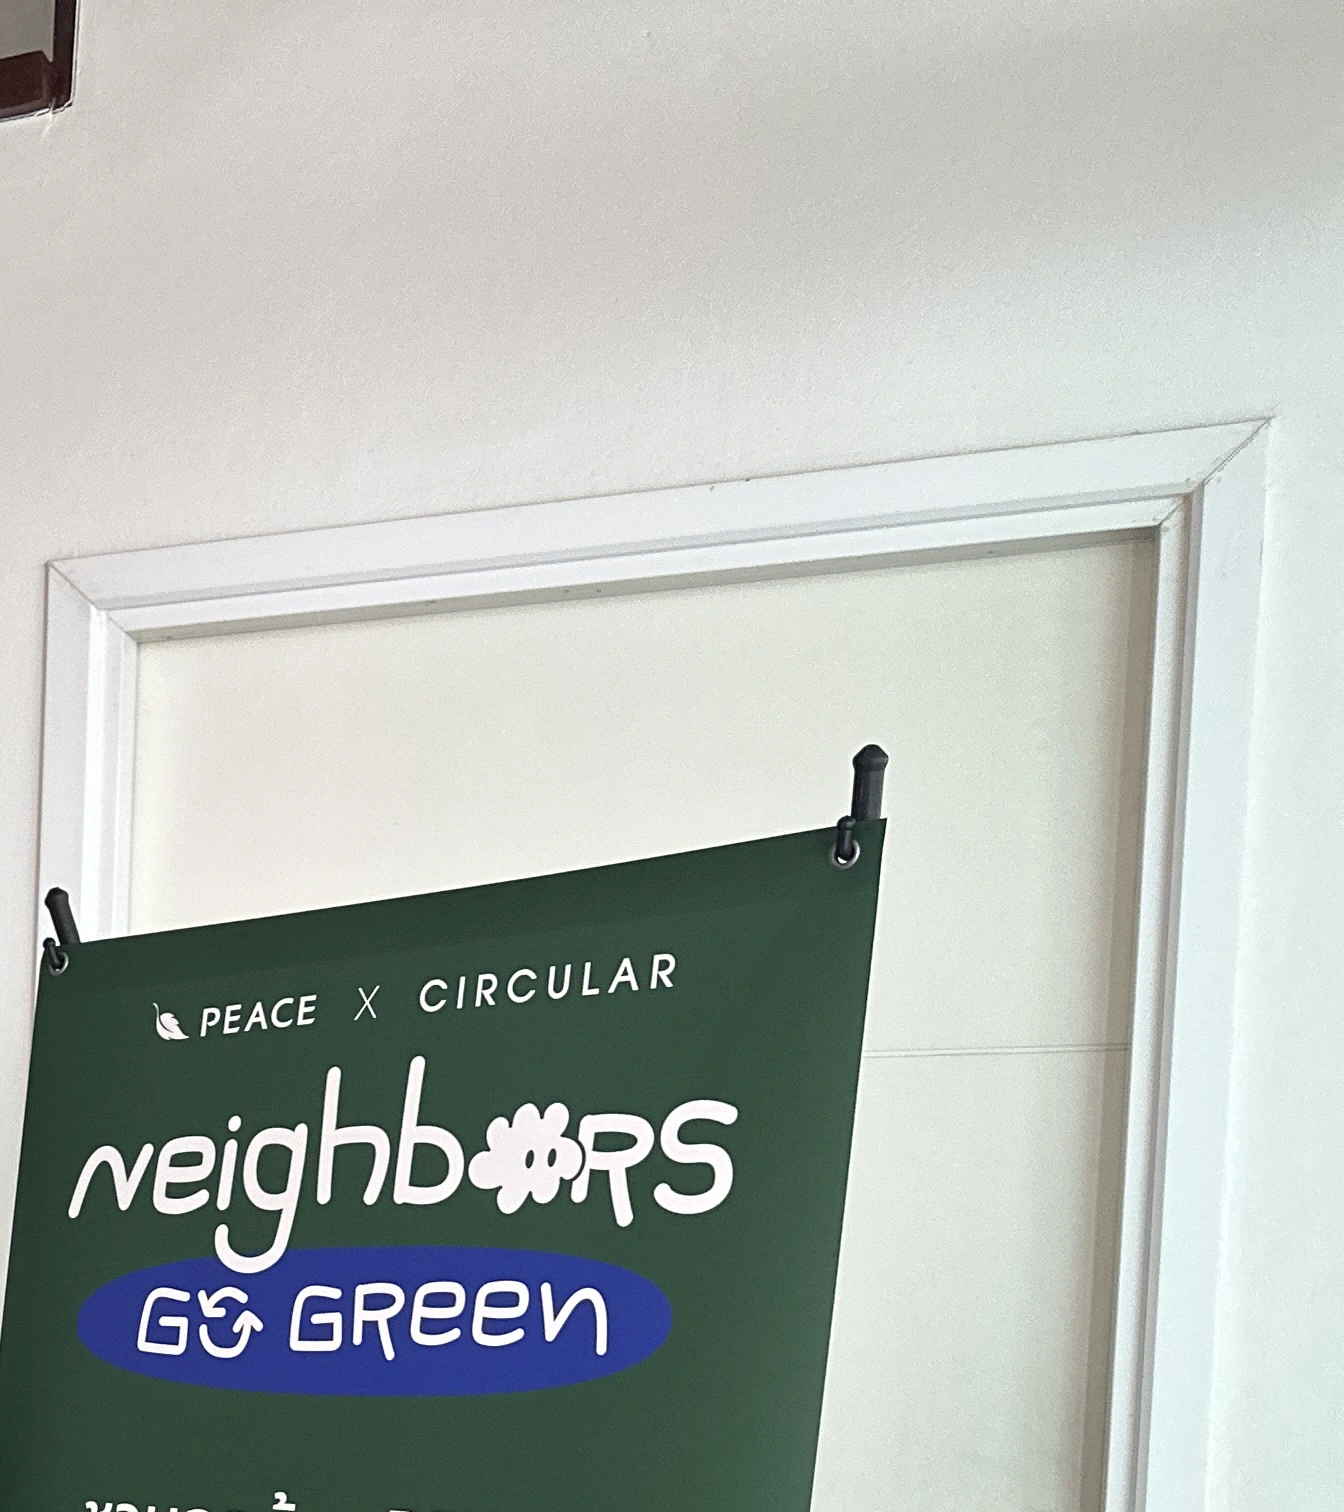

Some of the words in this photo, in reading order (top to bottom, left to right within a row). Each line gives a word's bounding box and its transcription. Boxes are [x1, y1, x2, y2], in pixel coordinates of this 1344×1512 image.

[200, 994, 317, 1037] PEACE
[353, 985, 380, 1021] X
[419, 953, 676, 1013] CIRCULAR
